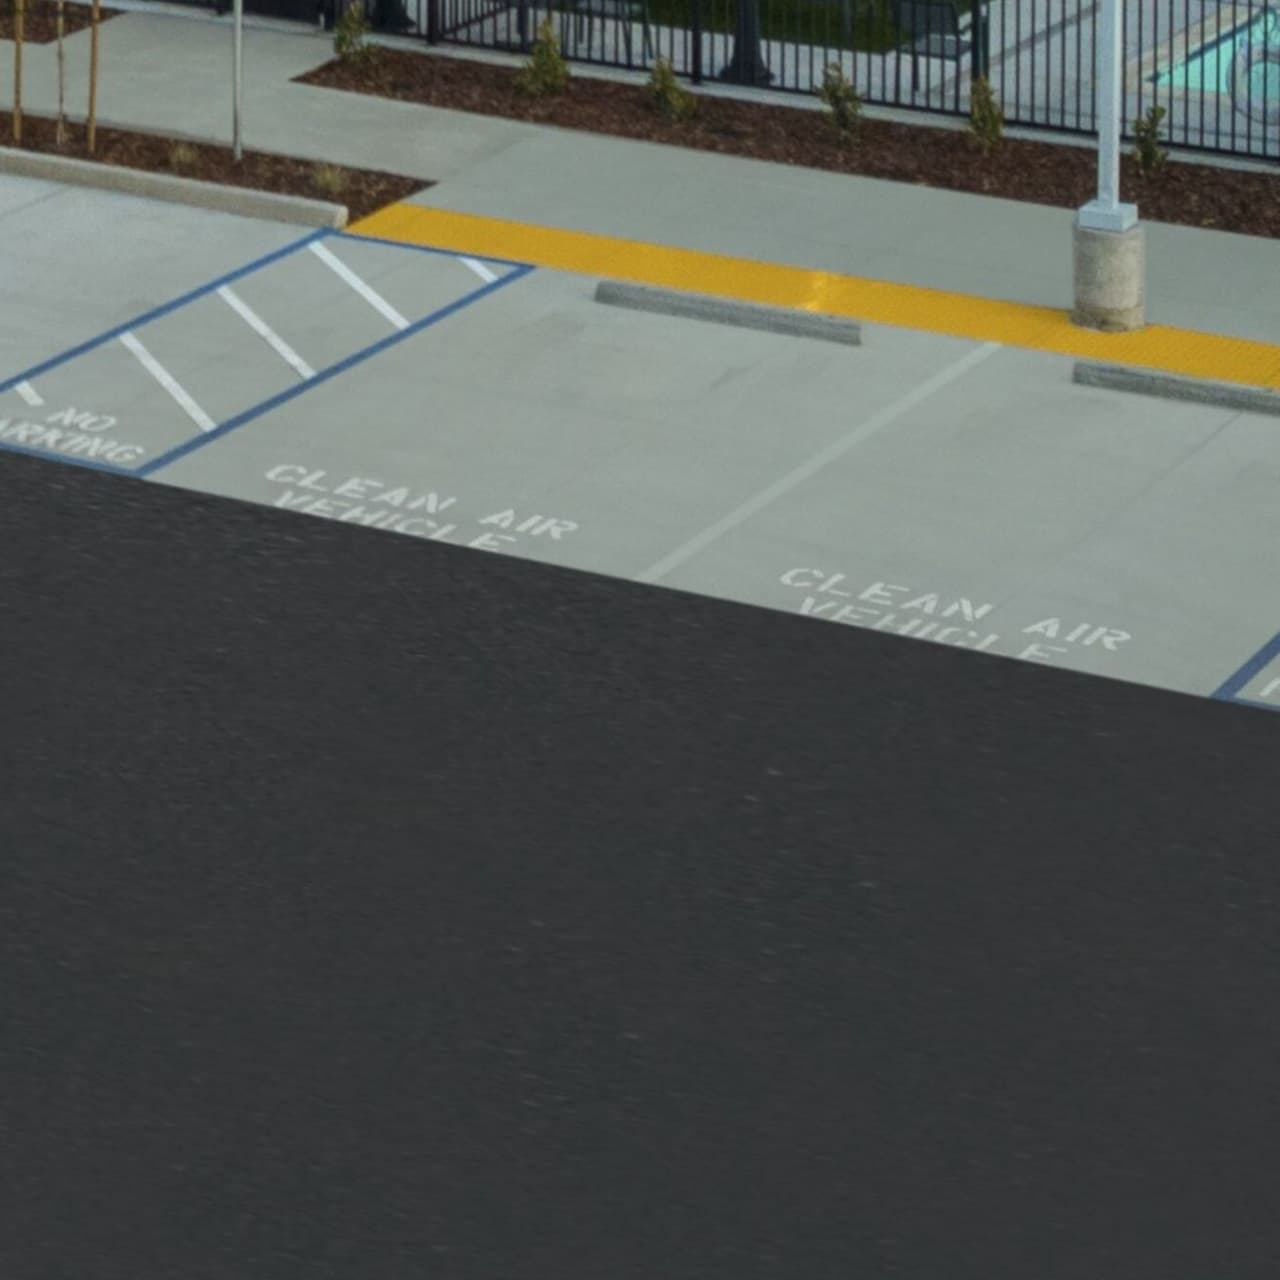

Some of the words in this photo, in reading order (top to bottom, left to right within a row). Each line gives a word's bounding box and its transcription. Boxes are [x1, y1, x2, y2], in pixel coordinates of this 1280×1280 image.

[46, 407, 118, 432] NO
[265, 464, 457, 513] CLEAN
[479, 508, 579, 539] AIR
[779, 568, 993, 621] CLEAN
[1022, 617, 1132, 651] AIR
